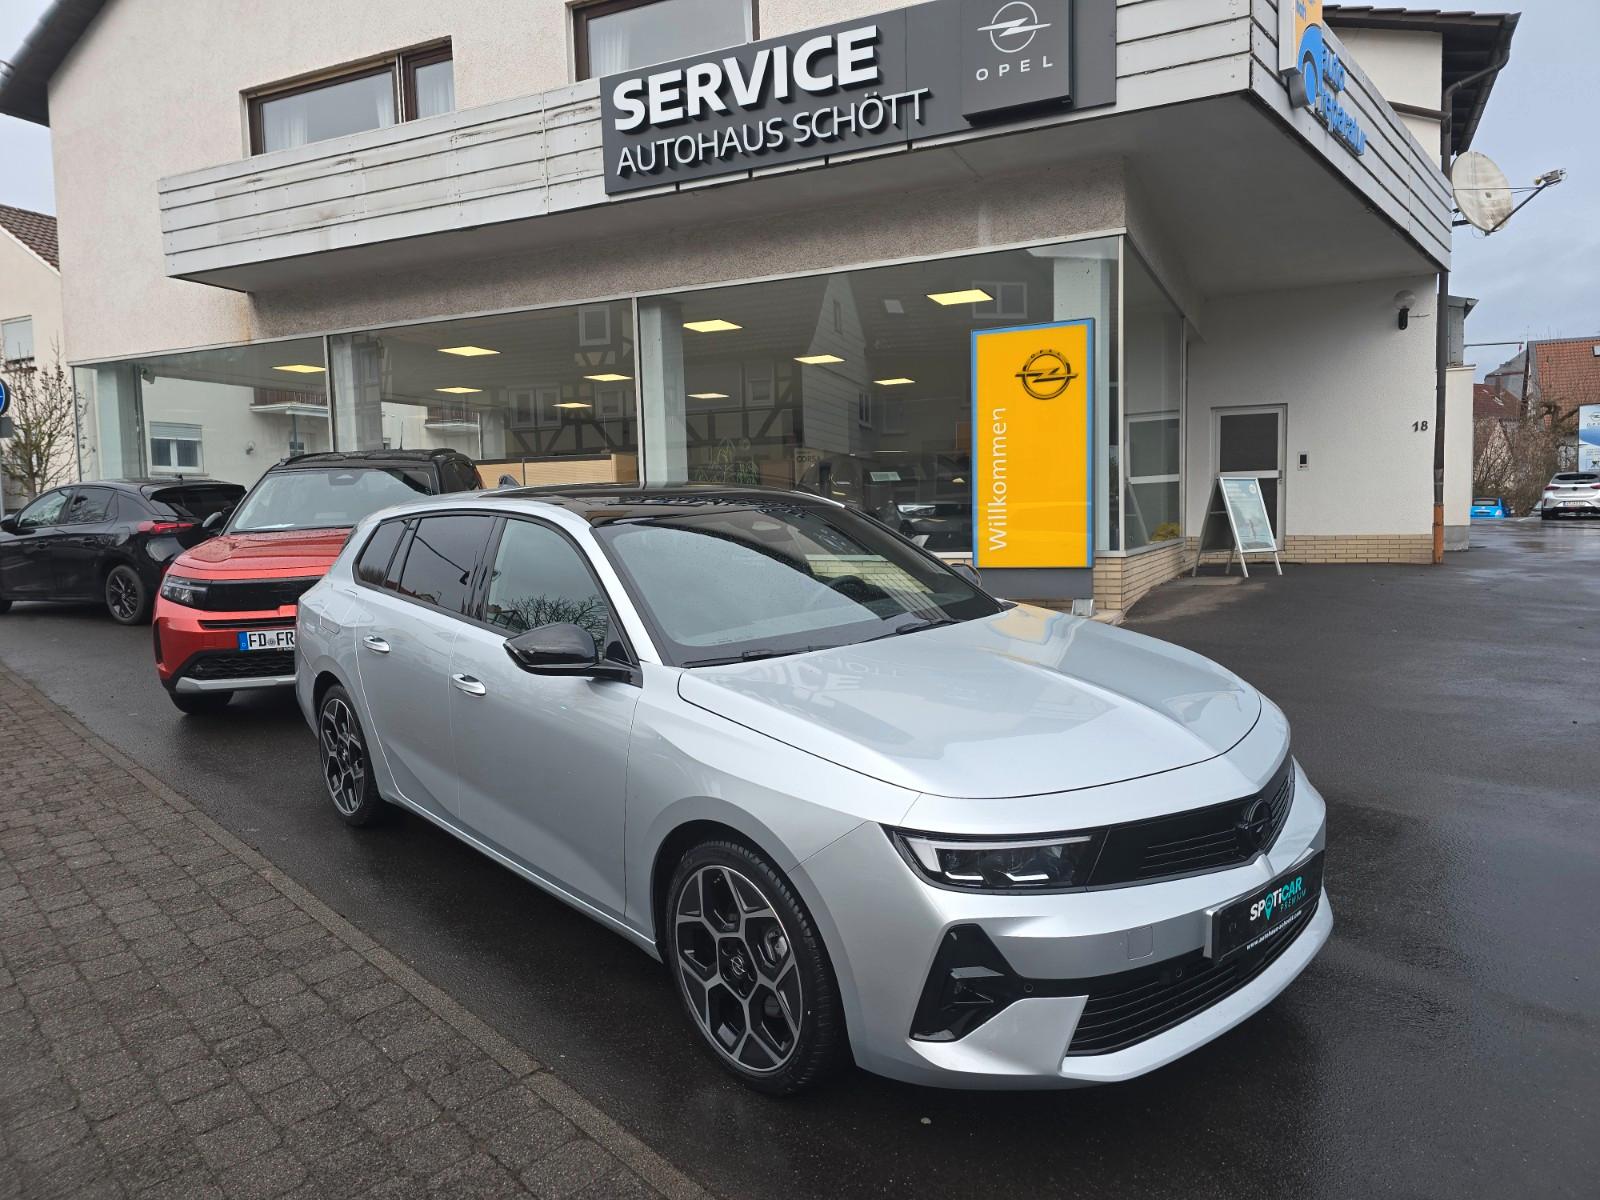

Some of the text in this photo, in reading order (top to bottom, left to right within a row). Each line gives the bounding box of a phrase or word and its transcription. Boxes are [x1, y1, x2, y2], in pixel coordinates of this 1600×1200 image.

[613, 24, 879, 131] SERVICE
[976, 56, 1053, 80] OPEL
[616, 87, 929, 175] AUTOHAUS SCHÖTT
[1411, 420, 1428, 432] 18
[987, 407, 1008, 551] Willkommen
